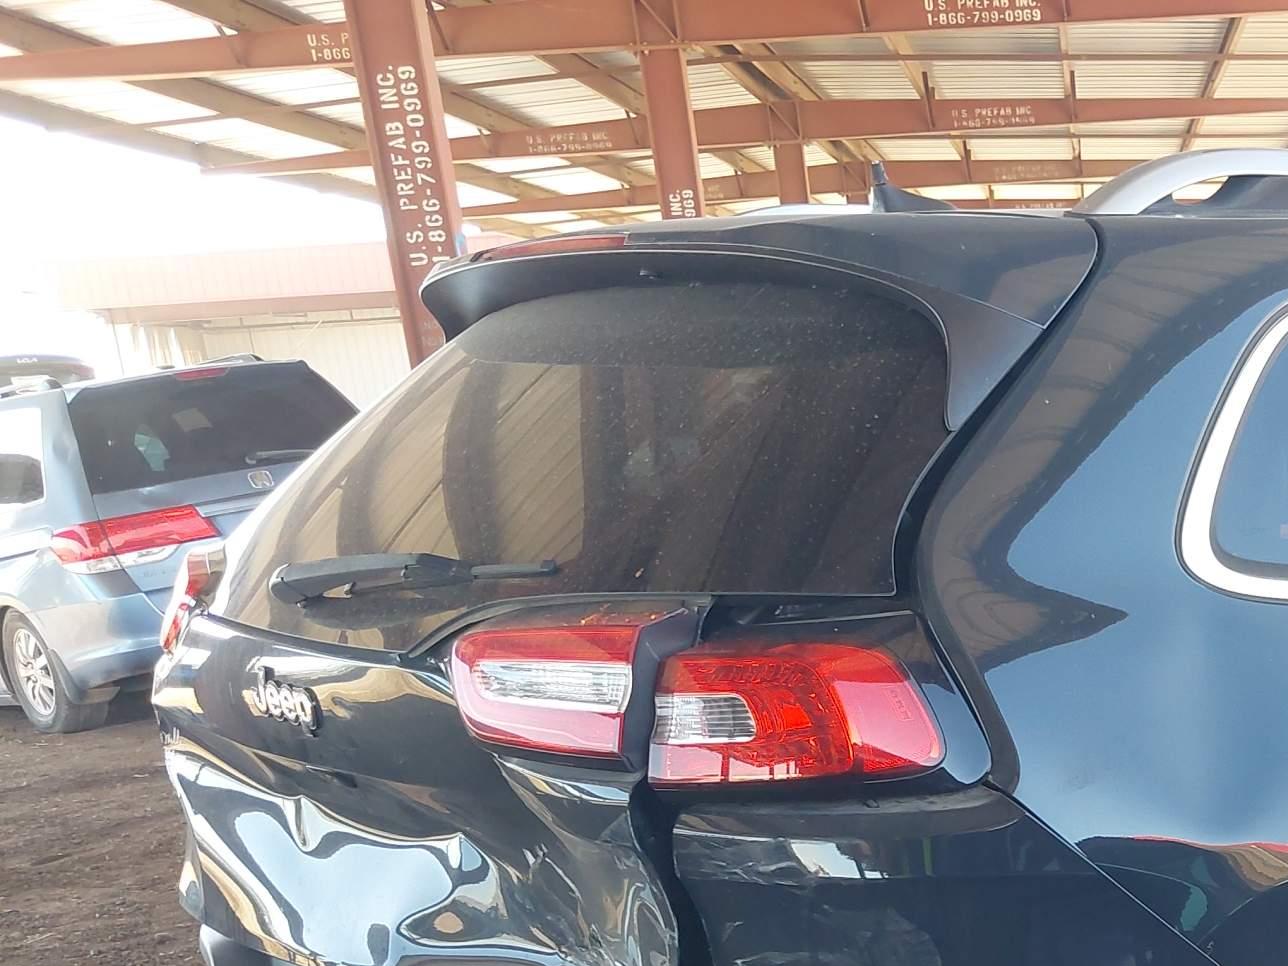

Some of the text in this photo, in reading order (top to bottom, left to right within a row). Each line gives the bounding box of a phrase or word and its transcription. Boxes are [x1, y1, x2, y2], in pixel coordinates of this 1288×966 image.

[306, 33, 335, 47] U.S.
[927, 8, 1041, 26] 1-866-799-0969
[375, 65, 429, 266] U.S. PREFAB INC.
[397, 65, 450, 263] 1-866-799-0969
[247, 665, 319, 736] Jeep
